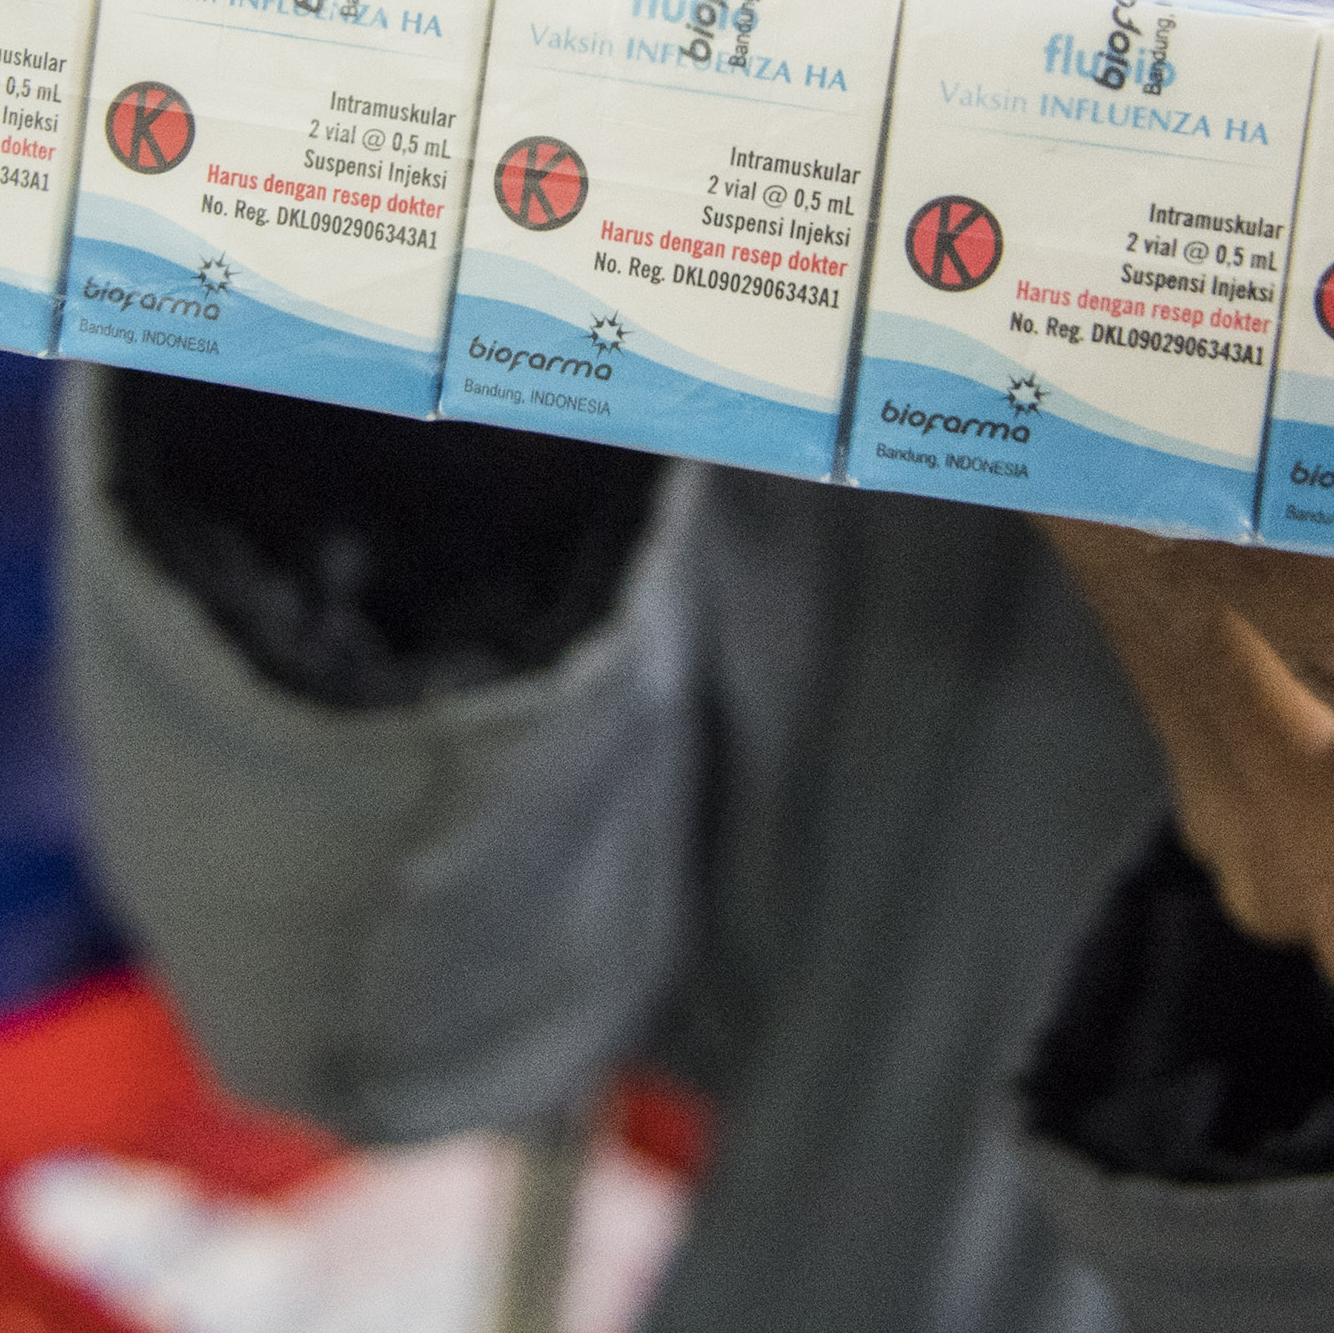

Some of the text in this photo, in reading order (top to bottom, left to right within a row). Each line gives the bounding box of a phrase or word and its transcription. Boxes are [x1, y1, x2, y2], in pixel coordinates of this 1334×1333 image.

[401, 11, 443, 38] HA
[530, 22, 613, 56] Vaksin
[805, 65, 847, 92] HA
[1142, 13, 1177, 96] Bandung,
[6, 76, 31, 98] 0,5
[36, 84, 62, 103] mL
[330, 91, 456, 128] Intramuskular
[2, 106, 58, 132] Injeksi
[940, 79, 1269, 146] Vaksin INFLUENZA HA
[1, 136, 56, 161] dokter
[309, 119, 451, 159] 2 vial @ 0,5 mL
[304, 149, 447, 189] Suspensi Injeksi
[730, 147, 861, 184] Intramuskular
[208, 164, 445, 219] Harus dengan resep dokter
[707, 175, 855, 216] 2 vial @ 0,5 mL
[201, 194, 437, 250] No. Reg. DKL0902906343A1
[702, 206, 851, 247] Suspensi Injeksi
[1149, 203, 1284, 239] Intramuskular
[601, 220, 848, 277] Harus dengan resep dokter
[1126, 232, 1139, 252] 2
[1144, 237, 1177, 257] vial
[1184, 241, 1209, 264] @
[1251, 251, 1277, 271] mL
[83, 277, 220, 320] biofarma
[594, 252, 839, 309] No. Reg. DKL0902906343A1
[1121, 264, 1275, 303] Suspensi Injeksi
[1017, 280, 1271, 334] Harus dengan resep dokter
[79, 318, 219, 354] Bandung, INDONESIA
[1010, 312, 1263, 366] No. Reg. DKL0902906343A1
[469, 335, 612, 380] biofarma
[464, 379, 611, 416] Bandung, INDONESIA
[881, 399, 1030, 443] biofarma
[945, 453, 1029, 478] INDONESIA
